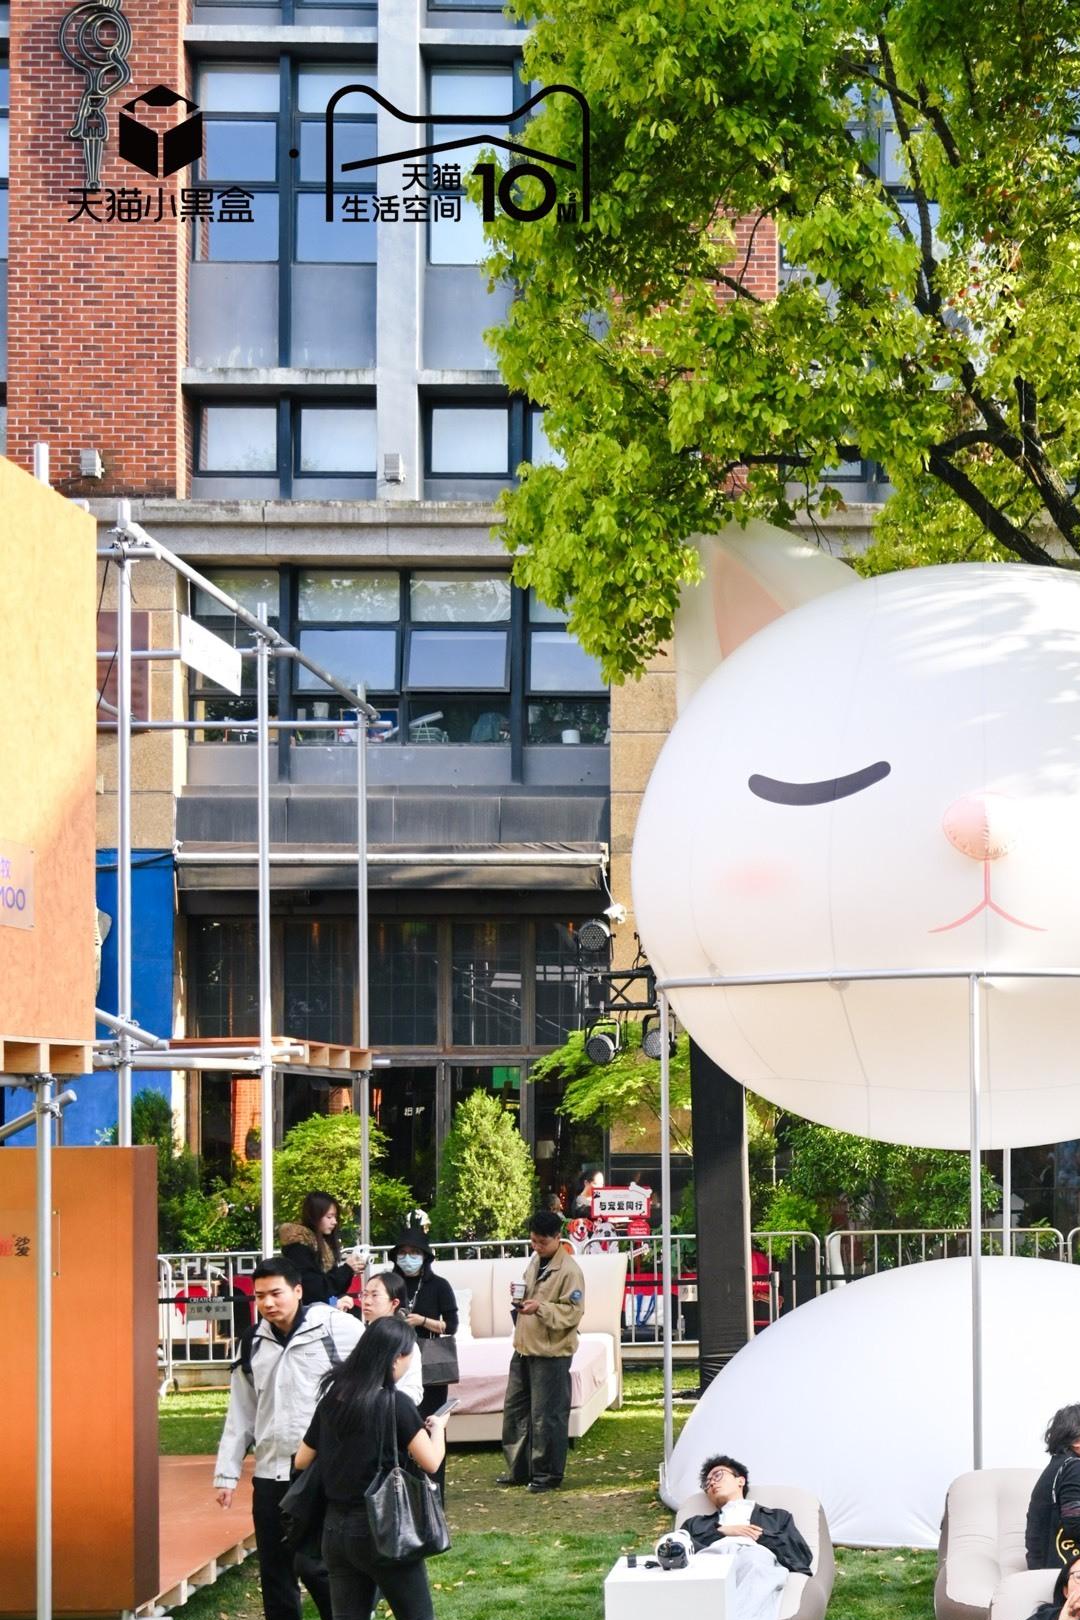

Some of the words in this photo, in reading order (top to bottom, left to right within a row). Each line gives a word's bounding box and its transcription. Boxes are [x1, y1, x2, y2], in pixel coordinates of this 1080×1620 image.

[599, 1201, 643, 1211] 与宠爱同行
